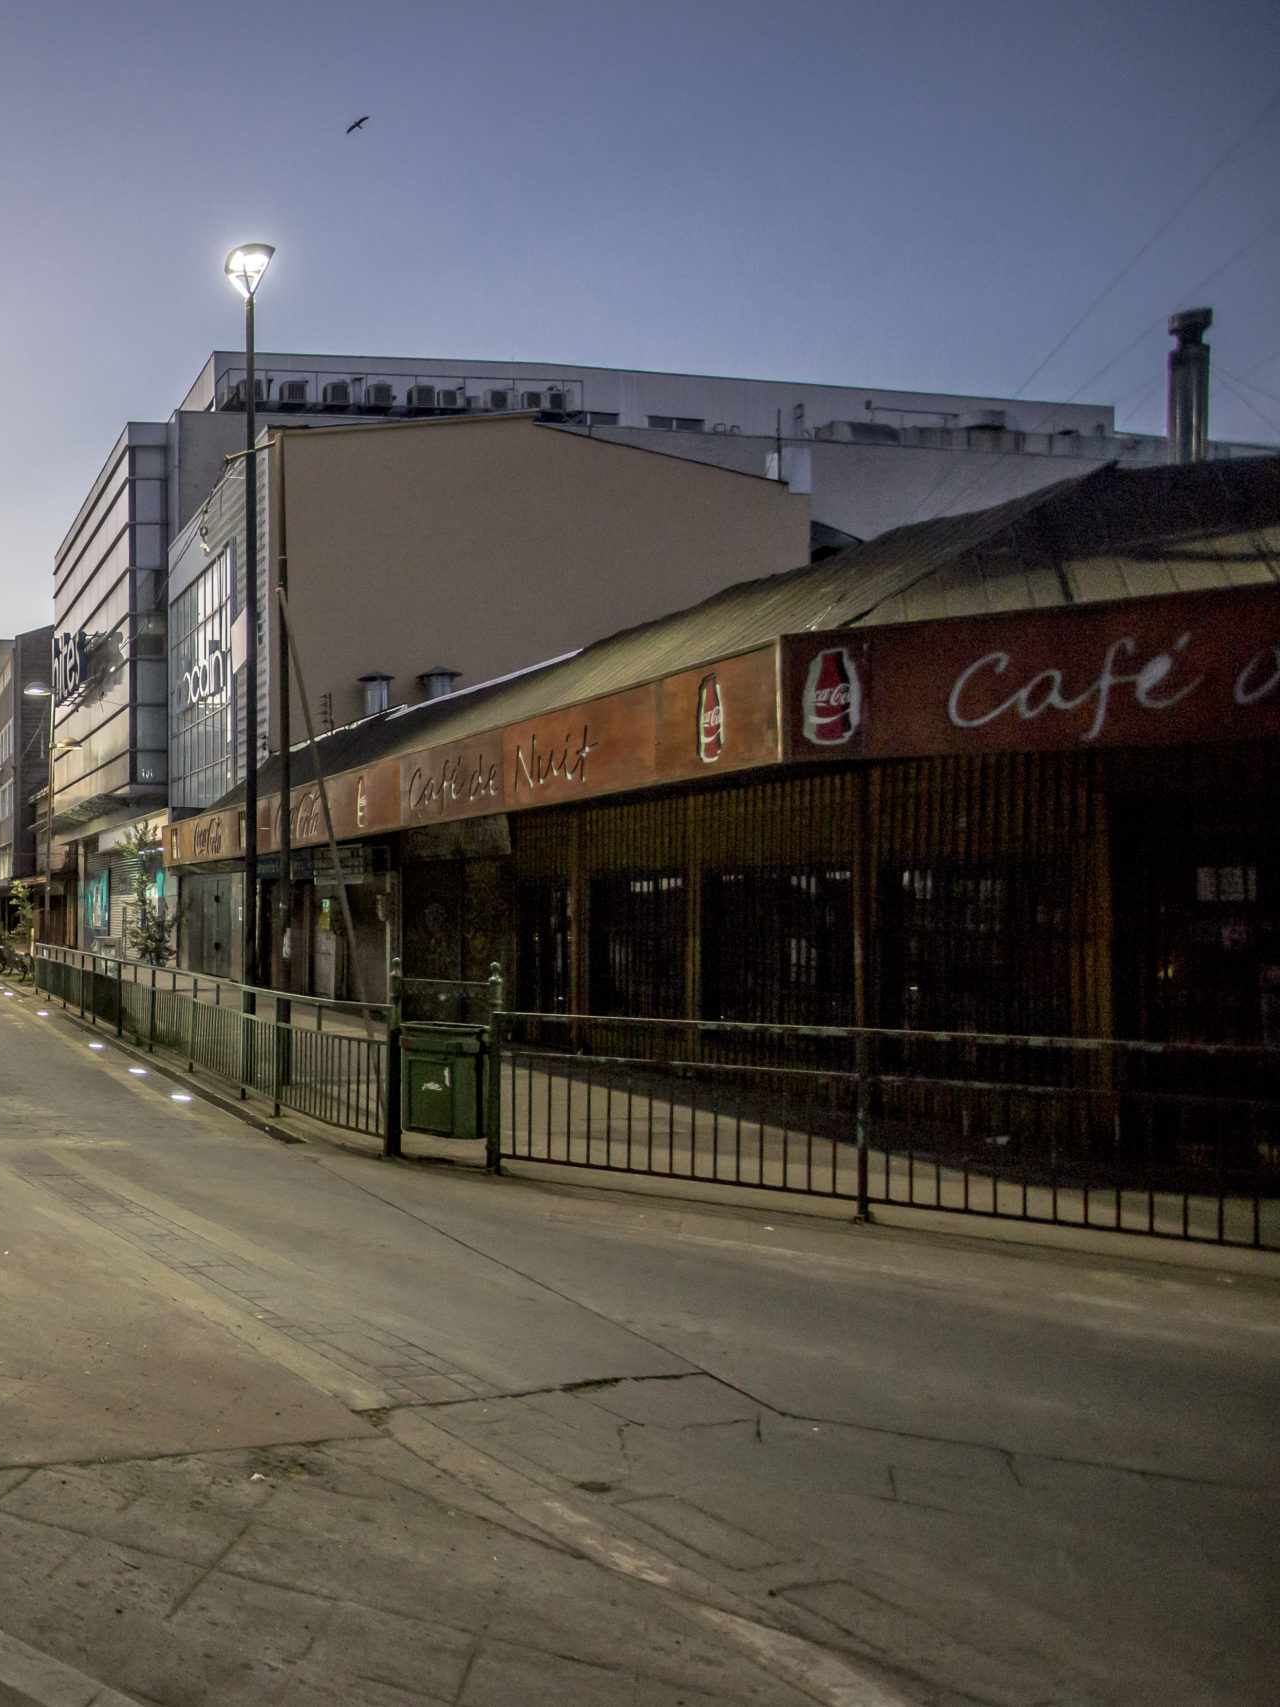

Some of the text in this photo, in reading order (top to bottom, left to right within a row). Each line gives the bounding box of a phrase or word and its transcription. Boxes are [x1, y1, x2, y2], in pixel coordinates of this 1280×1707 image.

[947, 631, 1204, 741] Café
[409, 726, 598, 815] Café de Nuit
